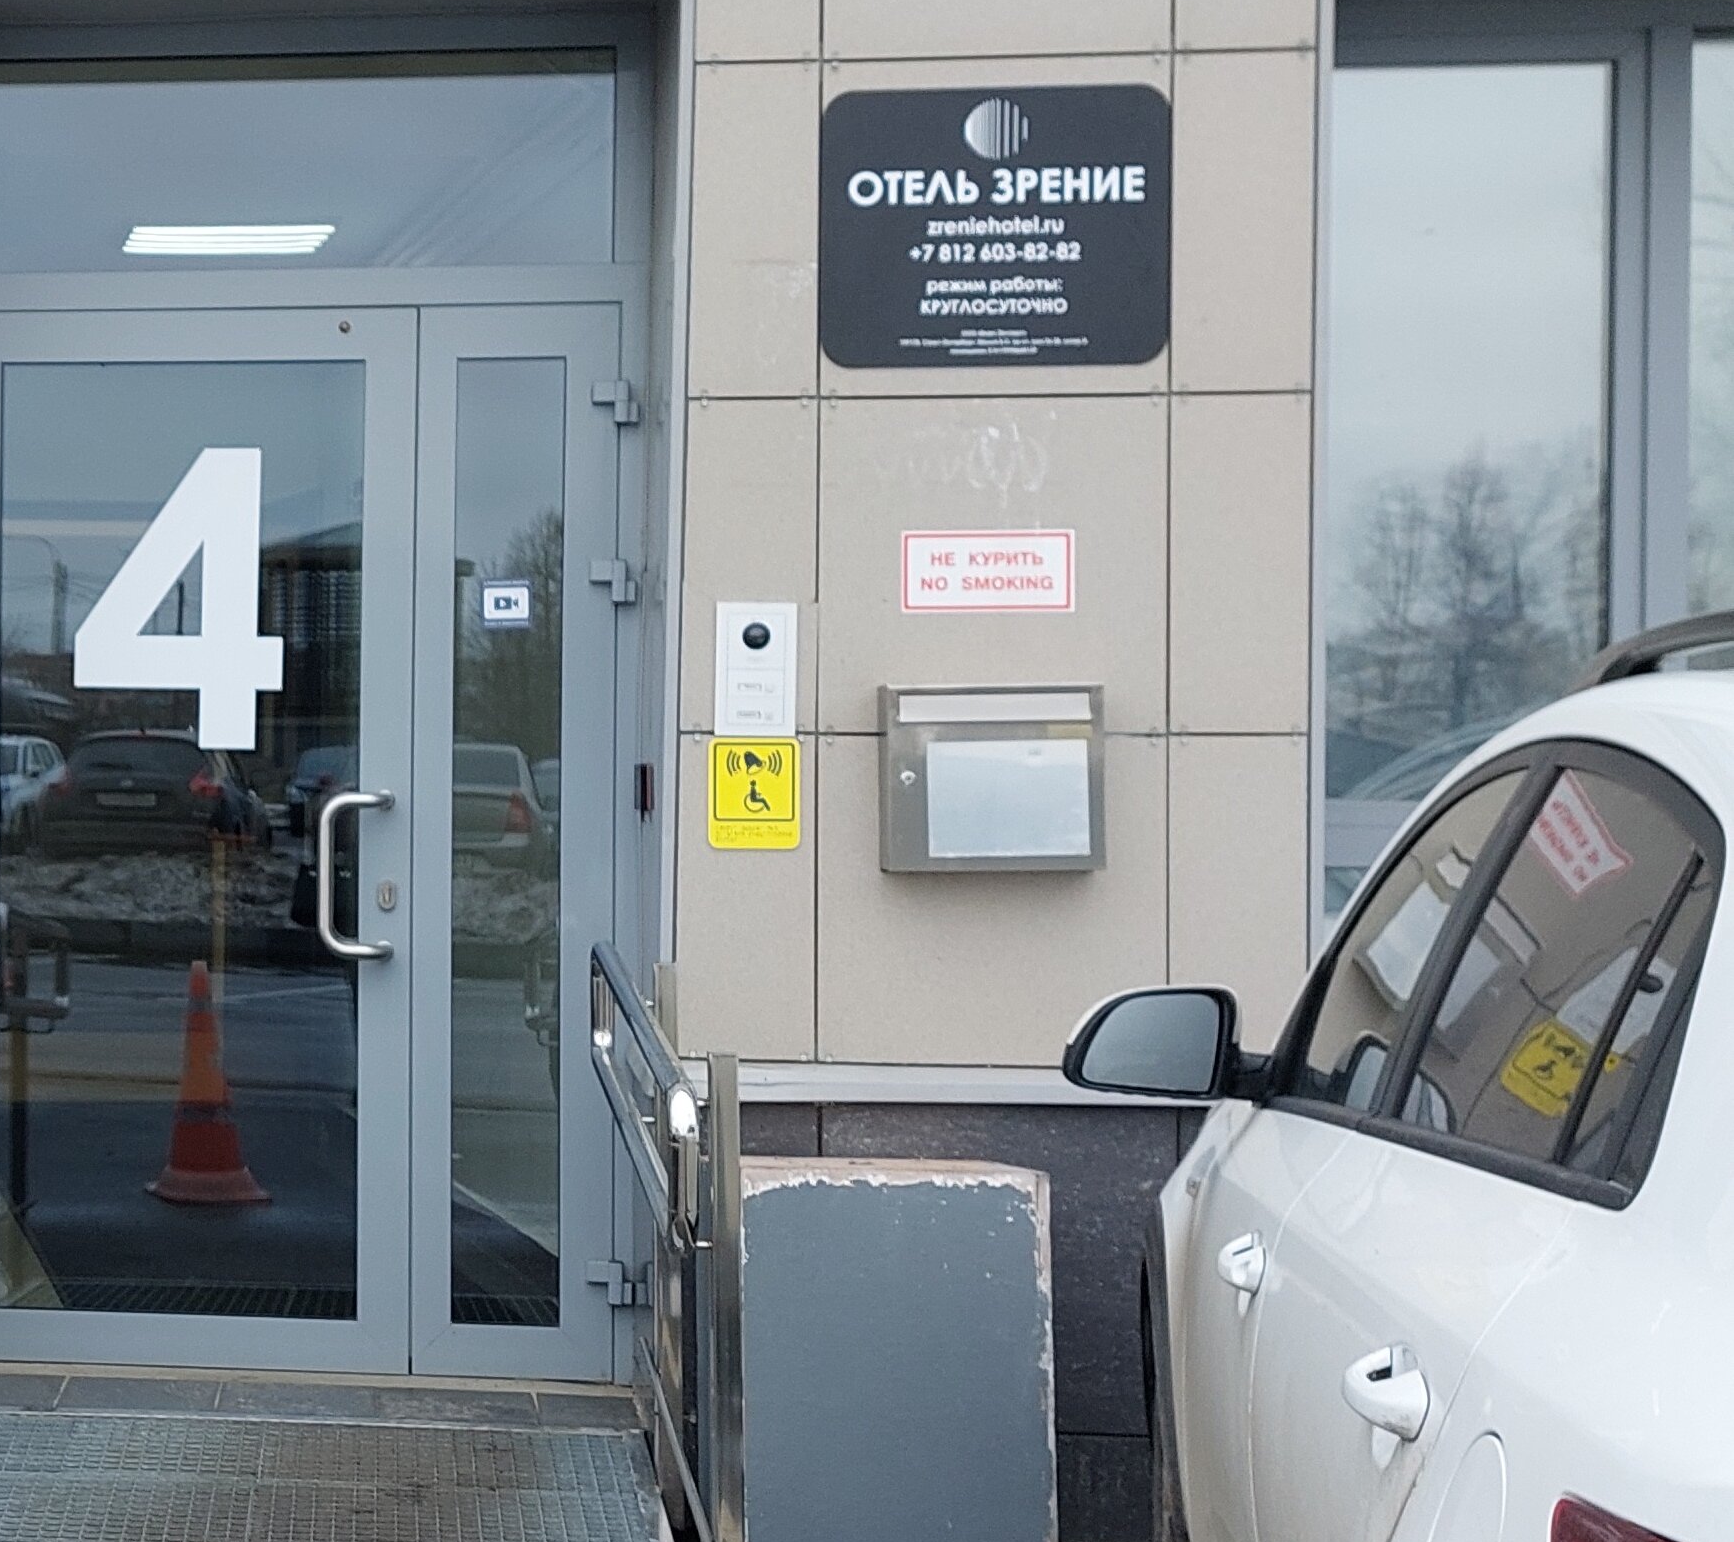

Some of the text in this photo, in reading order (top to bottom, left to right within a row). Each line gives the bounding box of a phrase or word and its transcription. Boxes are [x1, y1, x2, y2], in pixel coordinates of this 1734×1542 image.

[847, 165, 1146, 206] ОТЕЛЬ ЗРЕНИЕ
[926, 215, 1065, 236] zreniehotel.ru
[908, 240, 1082, 263] +7 812 603-82-82
[926, 275, 1064, 295] режим работы:
[919, 297, 1069, 316] КРУГЛОСУТОЧНО
[930, 551, 1044, 566] НЕ КУРИТЬ
[920, 576, 1054, 590] NO SMOKING
[74, 447, 284, 751] 4
